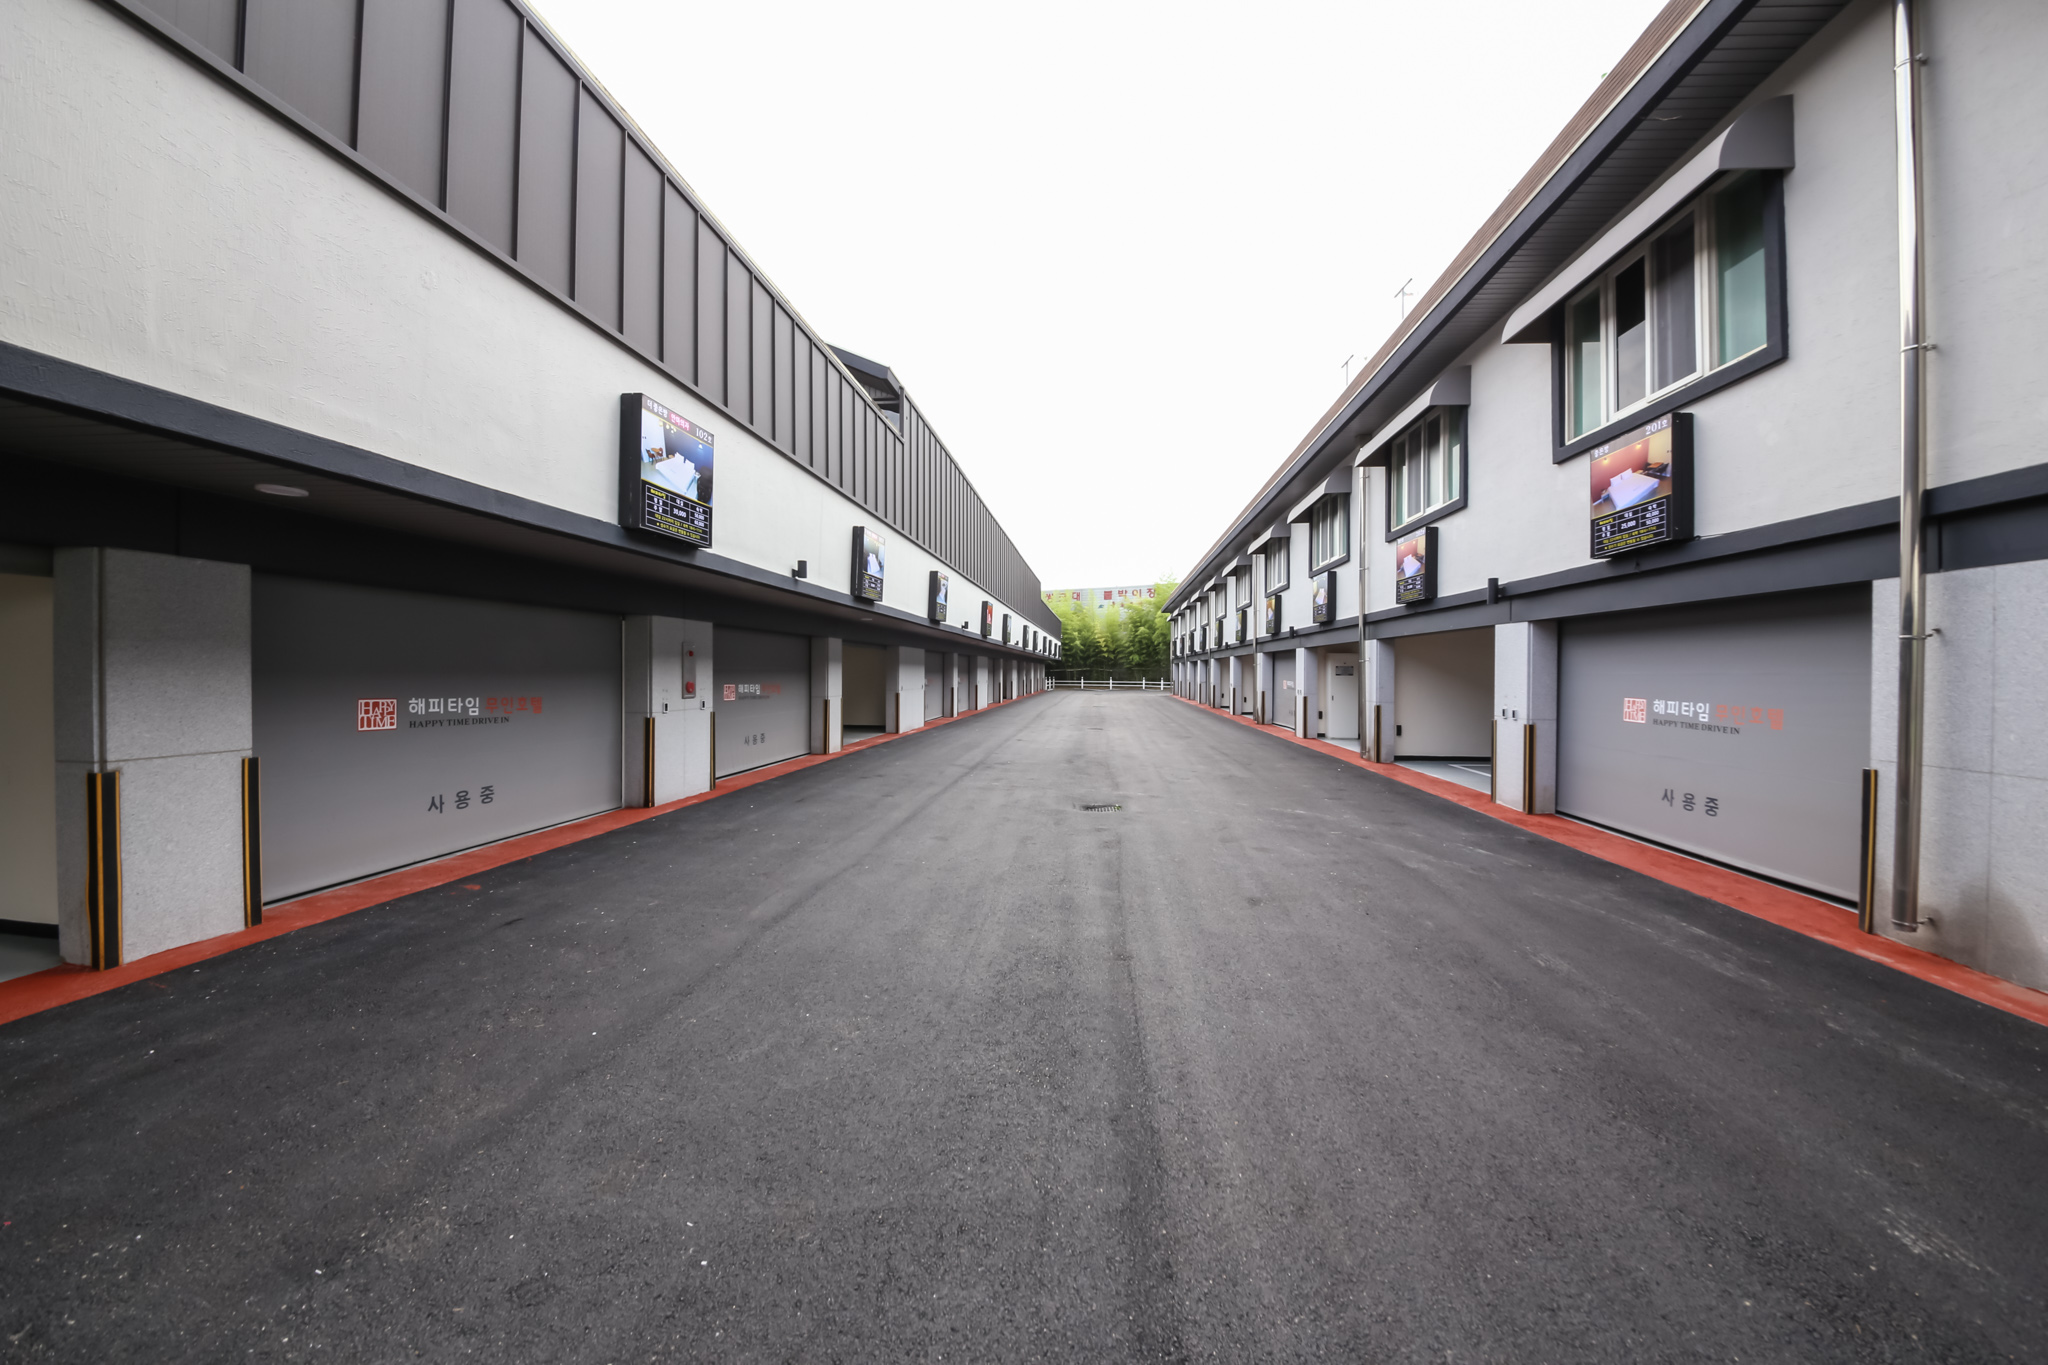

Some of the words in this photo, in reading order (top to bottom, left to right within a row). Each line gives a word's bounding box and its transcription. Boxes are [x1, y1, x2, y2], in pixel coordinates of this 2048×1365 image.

[408, 697, 480, 716] 해피타임
[485, 696, 543, 714] 무인호텔
[1652, 698, 1710, 722] 해피타임
[1715, 704, 1784, 730] 무인호텔
[409, 719, 445, 728] HAPPY
[446, 718, 470, 726] TIME
[472, 716, 500, 726] DRIVE
[500, 716, 510, 724] IN
[1652, 718, 1678, 728] HAPPY
[1680, 720, 1700, 731] TIME
[1701, 724, 1728, 734] DRIVE
[1730, 727, 1741, 735] IN
